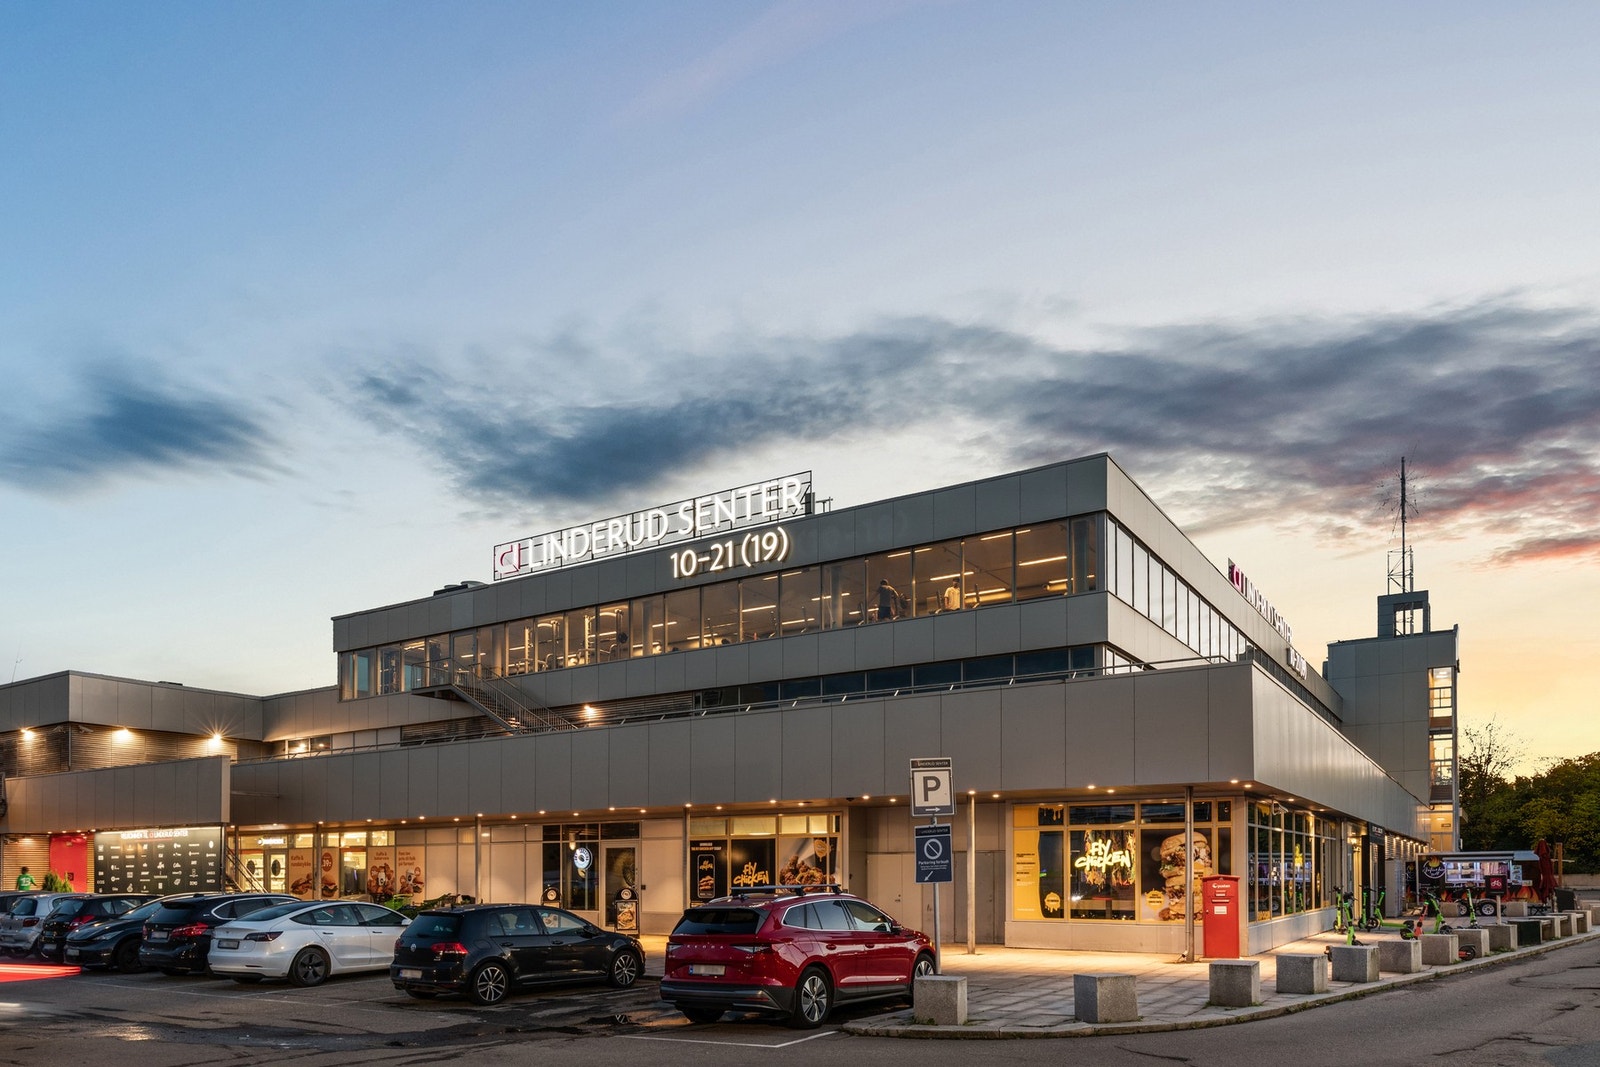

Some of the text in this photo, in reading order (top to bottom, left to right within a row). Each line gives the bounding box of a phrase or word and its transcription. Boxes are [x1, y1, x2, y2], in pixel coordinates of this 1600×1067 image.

[528, 477, 803, 569] LINDERUD SENTER
[740, 527, 789, 567] (19)
[923, 776, 941, 802] P
[733, 871, 769, 887] CHICKEN
